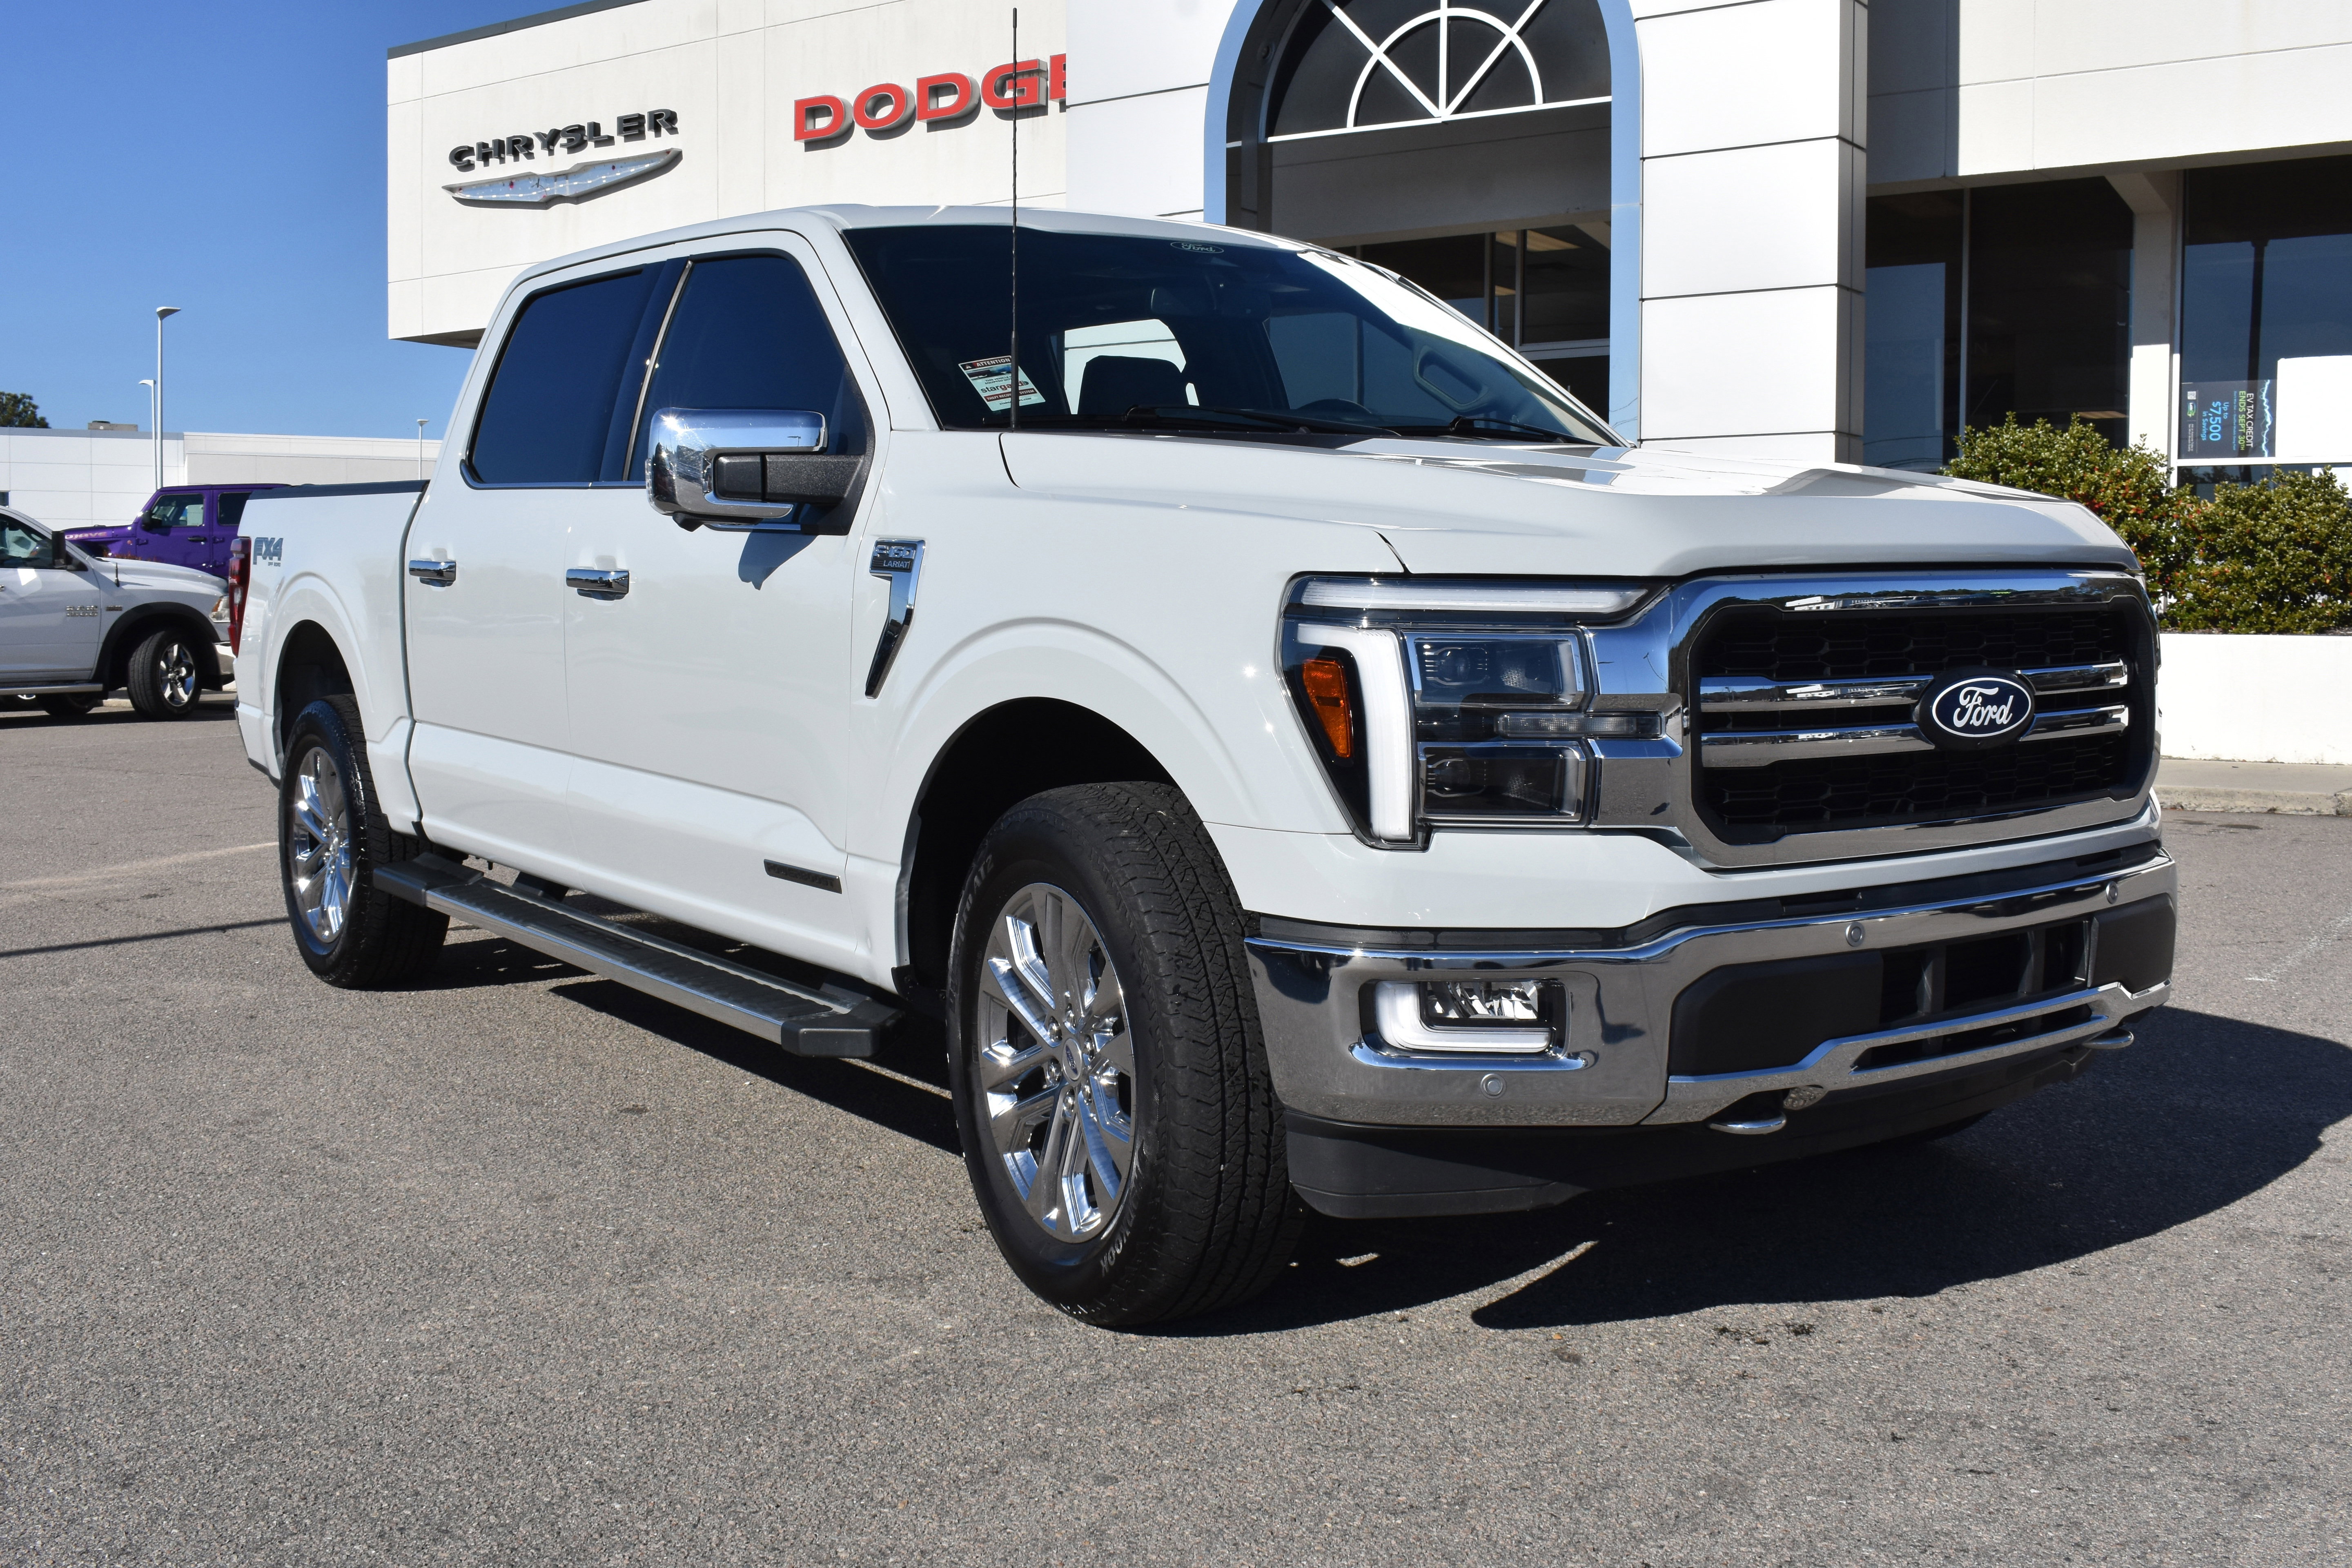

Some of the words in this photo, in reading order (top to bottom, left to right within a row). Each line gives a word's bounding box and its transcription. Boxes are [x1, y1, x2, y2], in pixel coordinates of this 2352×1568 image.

[449, 109, 678, 168] CHRYSLER
[1181, 243, 1216, 252] Ford
[976, 358, 1011, 367] ATTENTION
[981, 381, 1024, 393] stargad
[2247, 393, 2254, 403] EV
[2222, 402, 2229, 411] Up
[2209, 401, 2221, 441] $7,500
[253, 537, 284, 565] FX4
[1953, 686, 2014, 728] Ford
